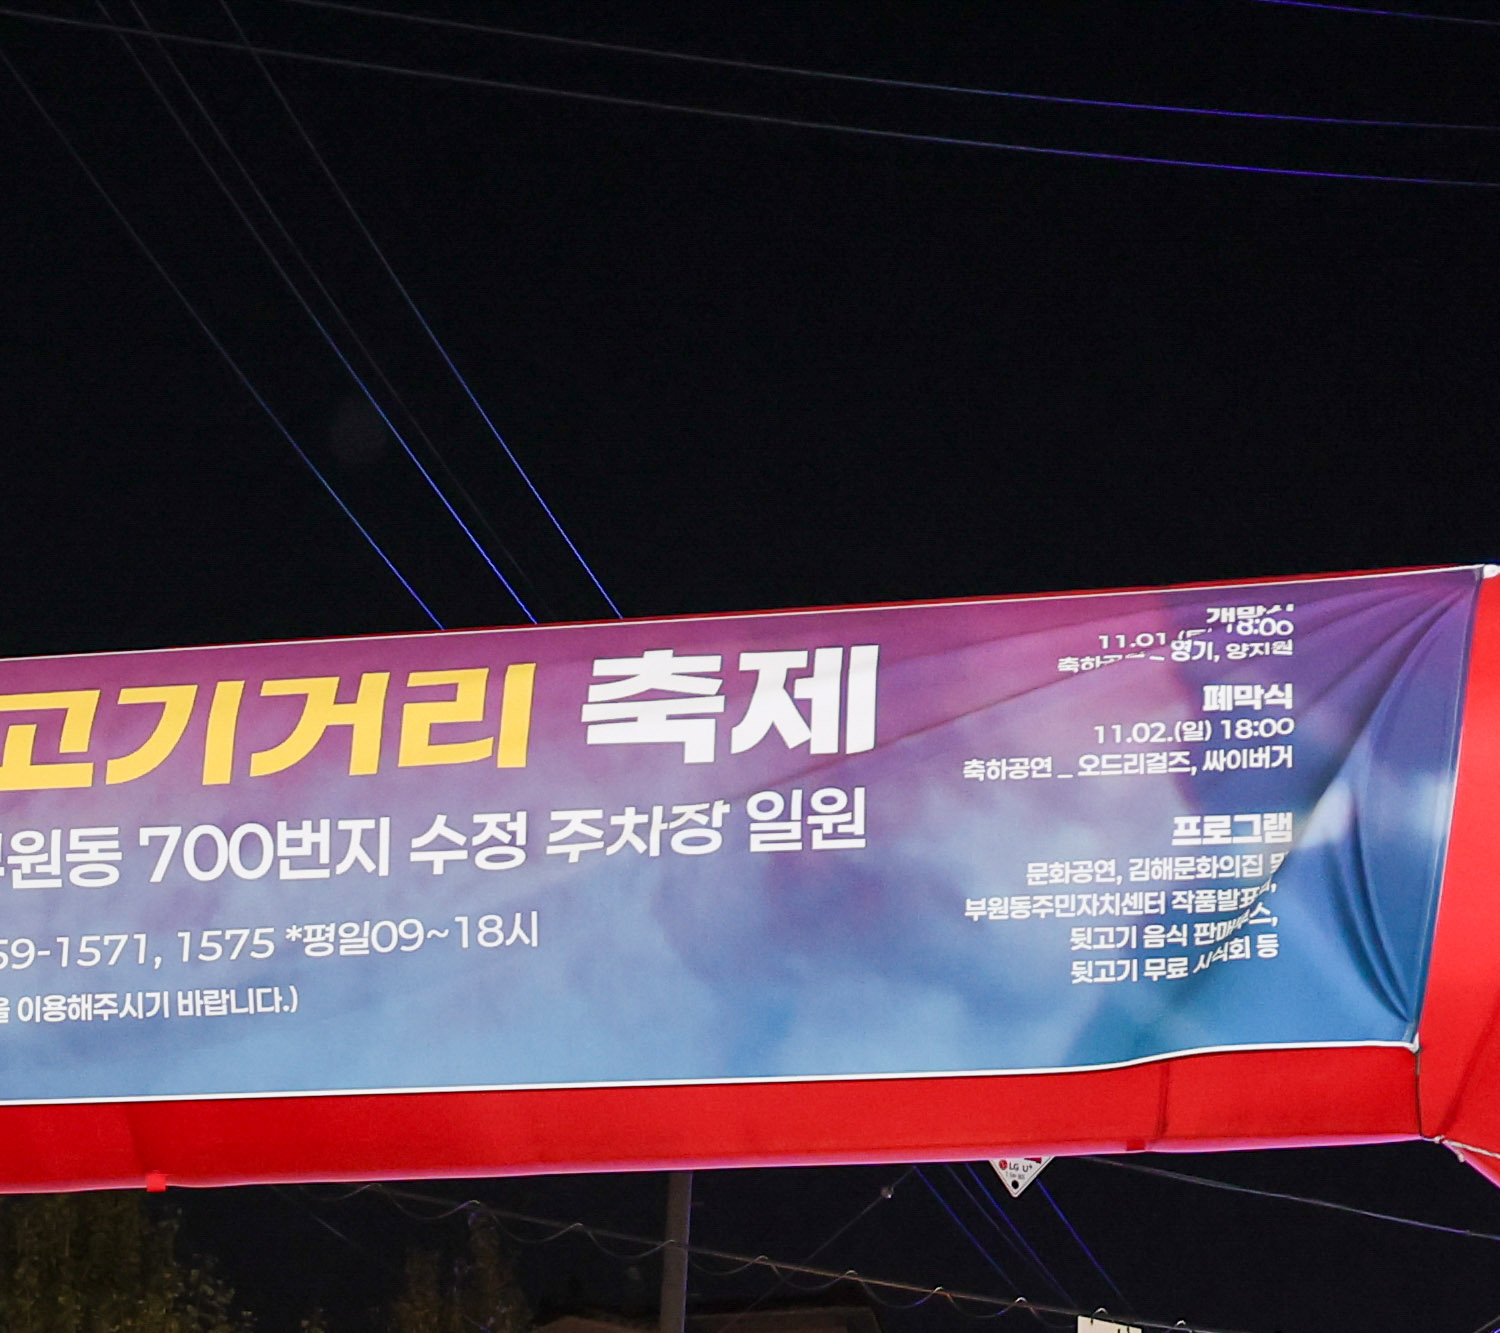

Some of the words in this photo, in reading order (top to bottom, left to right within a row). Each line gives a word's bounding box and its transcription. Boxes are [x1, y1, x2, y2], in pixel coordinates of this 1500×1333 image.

[1171, 638, 1220, 662] 영기,
[1225, 640, 1293, 659] 양지원
[581, 643, 878, 764] 축제
[1202, 683, 1293, 711] 폐막식
[1093, 719, 1212, 744] 11.02.(일)
[1220, 718, 1294, 740] 18:00
[962, 756, 1052, 782] 축하공연
[1077, 749, 1198, 779] 오드리걸즈,
[1203, 745, 1294, 774] 싸이버거
[139, 815, 391, 884] 700번지
[409, 811, 527, 875] 수정
[545, 799, 730, 864] 주차장
[745, 786, 867, 852] 일원
[1172, 811, 1293, 846] 프로그램
[1026, 859, 1122, 886] 문화공연,
[1129, 854, 1263, 882] 김해문화의집
[964, 889, 1166, 922] 부원동주민자치센터
[177, 927, 276, 963] 1575
[1070, 925, 1137, 951] 뒷고기
[1143, 924, 1187, 949] 음식
[1071, 958, 1138, 984] 뒷고기
[1144, 957, 1188, 980] 무료
[1255, 934, 1279, 958] 등
[17, 991, 171, 1024] 이용해주시기
[176, 986, 299, 1019] 바랍니다.)
